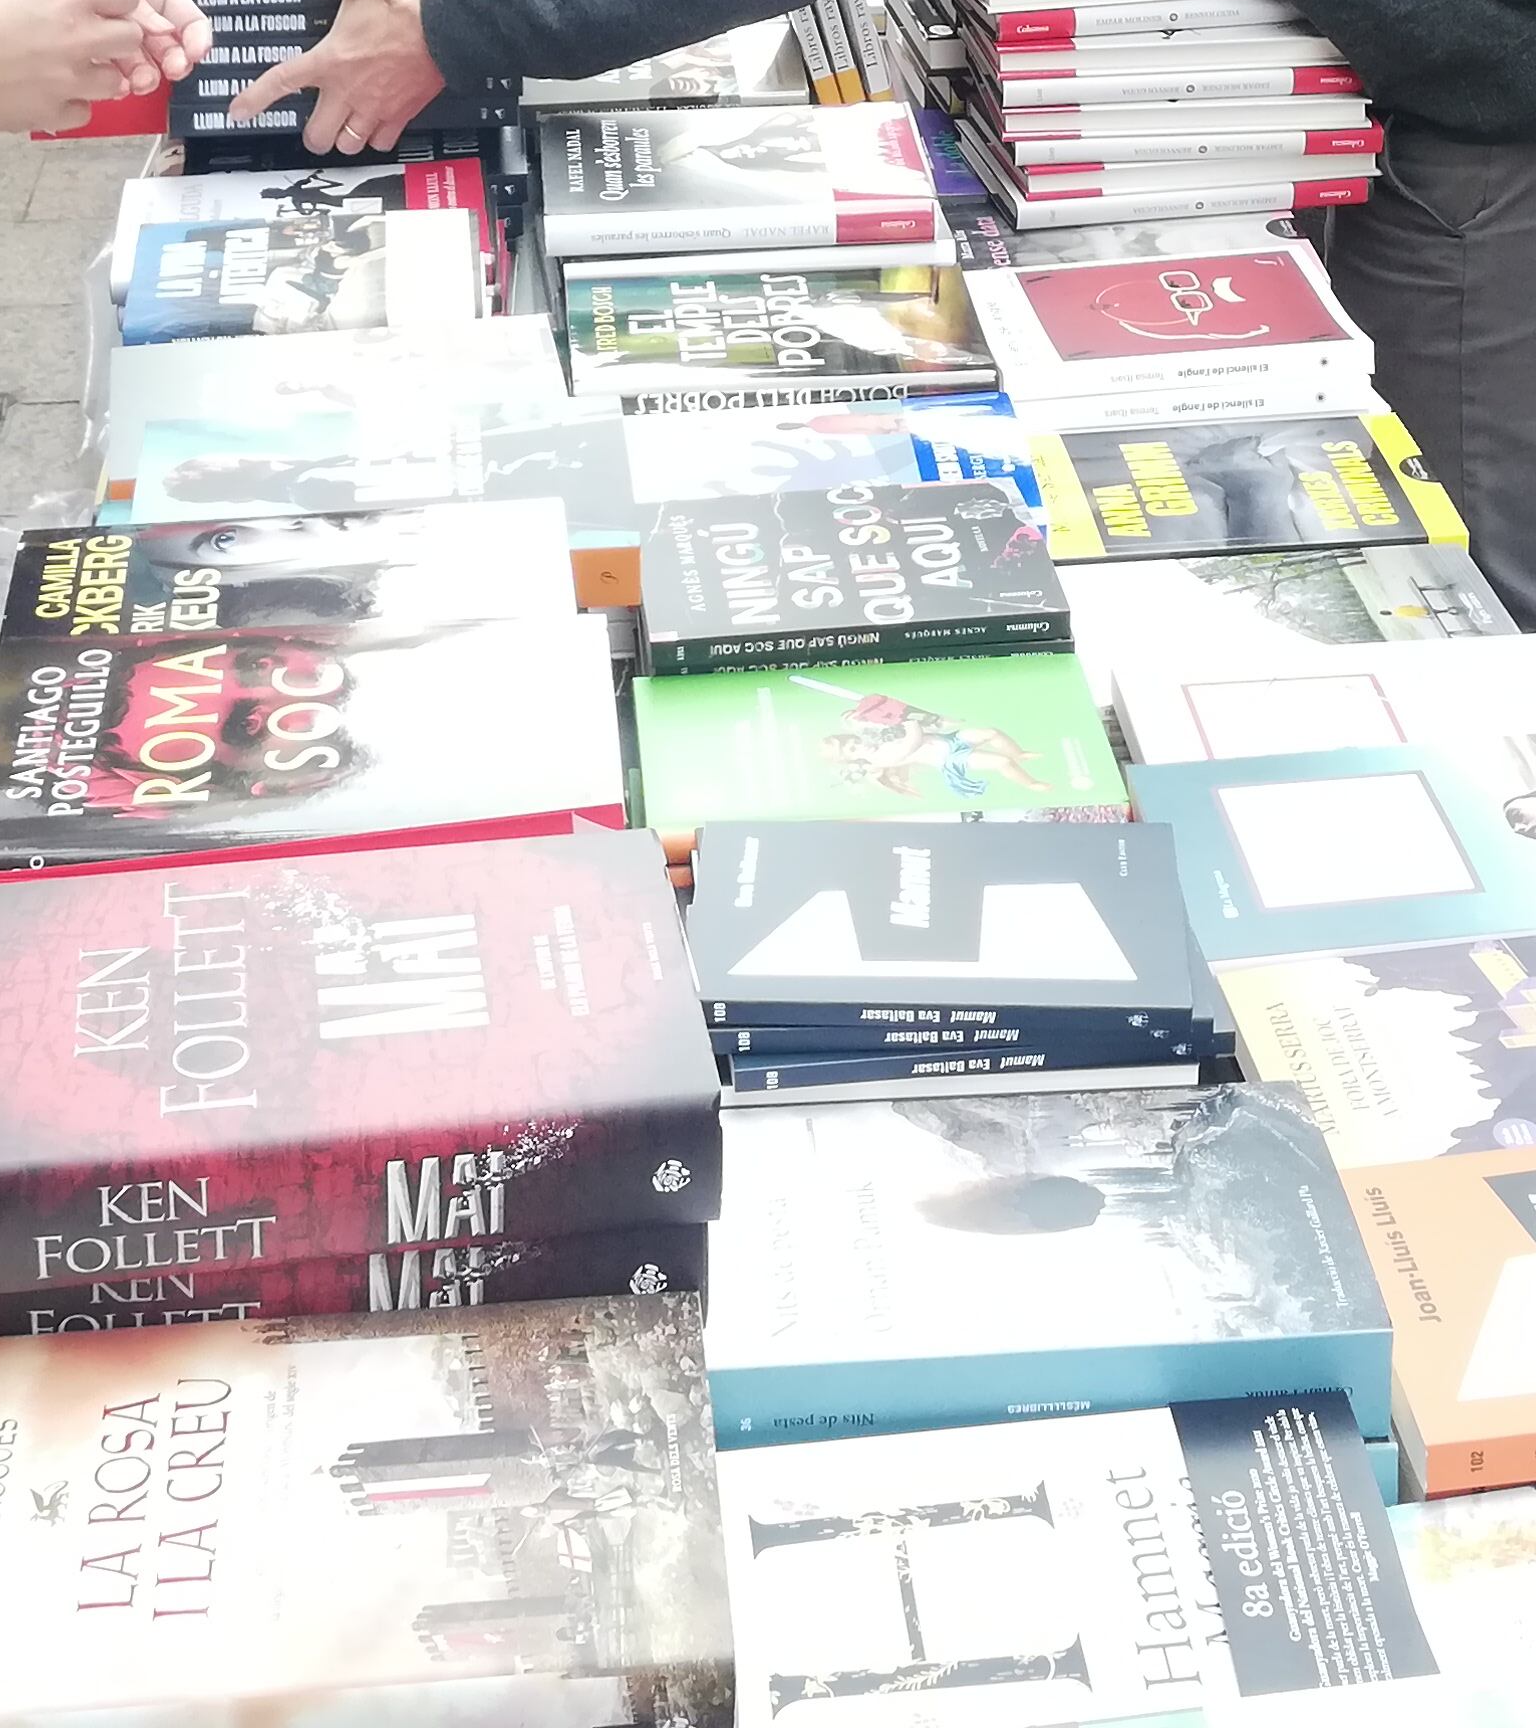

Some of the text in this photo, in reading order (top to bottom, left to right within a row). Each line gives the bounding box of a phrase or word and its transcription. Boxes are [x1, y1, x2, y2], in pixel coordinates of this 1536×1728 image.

[261, 14, 306, 31] FOSCOR
[803, 25, 825, 73] Libros
[830, 24, 851, 72] Libros
[856, 20, 878, 69] Libros
[198, 79, 229, 97] LLUM
[193, 112, 225, 130] LLUM
[566, 128, 585, 194] RAFEL NADAL
[599, 168, 629, 202] Quan
[629, 127, 661, 188] les paraules
[593, 285, 615, 323] BOSCH
[626, 308, 676, 334] EL
[670, 279, 728, 364] TEMPLE
[718, 291, 772, 344] DELS
[759, 273, 826, 370] POBRES
[634, 388, 811, 415] DELS POBRES
[1118, 441, 1200, 518] GRIMM
[1321, 440, 1402, 528] CRIMINALS
[1092, 484, 1154, 538] ANNA
[36, 537, 83, 620] CAMILLA
[697, 519, 782, 626] NINGÚ
[780, 544, 844, 610] SAP
[1005, 621, 1051, 633] Columna
[5, 665, 67, 801] SANTIAGO
[47, 647, 114, 818] POSTEGUILLO
[132, 643, 228, 808] ROMA
[888, 845, 932, 929] Mamut
[74, 945, 155, 1058] KEN
[160, 880, 259, 1120] FOLLETT
[860, 1008, 997, 1024] Mamut Eva Baltasar
[884, 1027, 1020, 1044] Mamut Eva Baltasar
[912, 1053, 1046, 1074] Mamut Eva Baltasar
[34, 1148, 508, 1282] FOLLETT MAI
[97, 1176, 212, 1227] KEN
[1365, 1186, 1443, 1322] Joan-Lluís Lluís
[89, 1274, 196, 1304] KEN
[771, 1410, 876, 1431] Nits pesta
[154, 1377, 233, 1587] LA CREU
[1470, 1450, 1485, 1473] 102
[76, 1392, 162, 1612] LA ROSA
[1108, 1465, 1202, 1690] Hamnet
[1208, 1489, 1275, 1619] 8a edició
